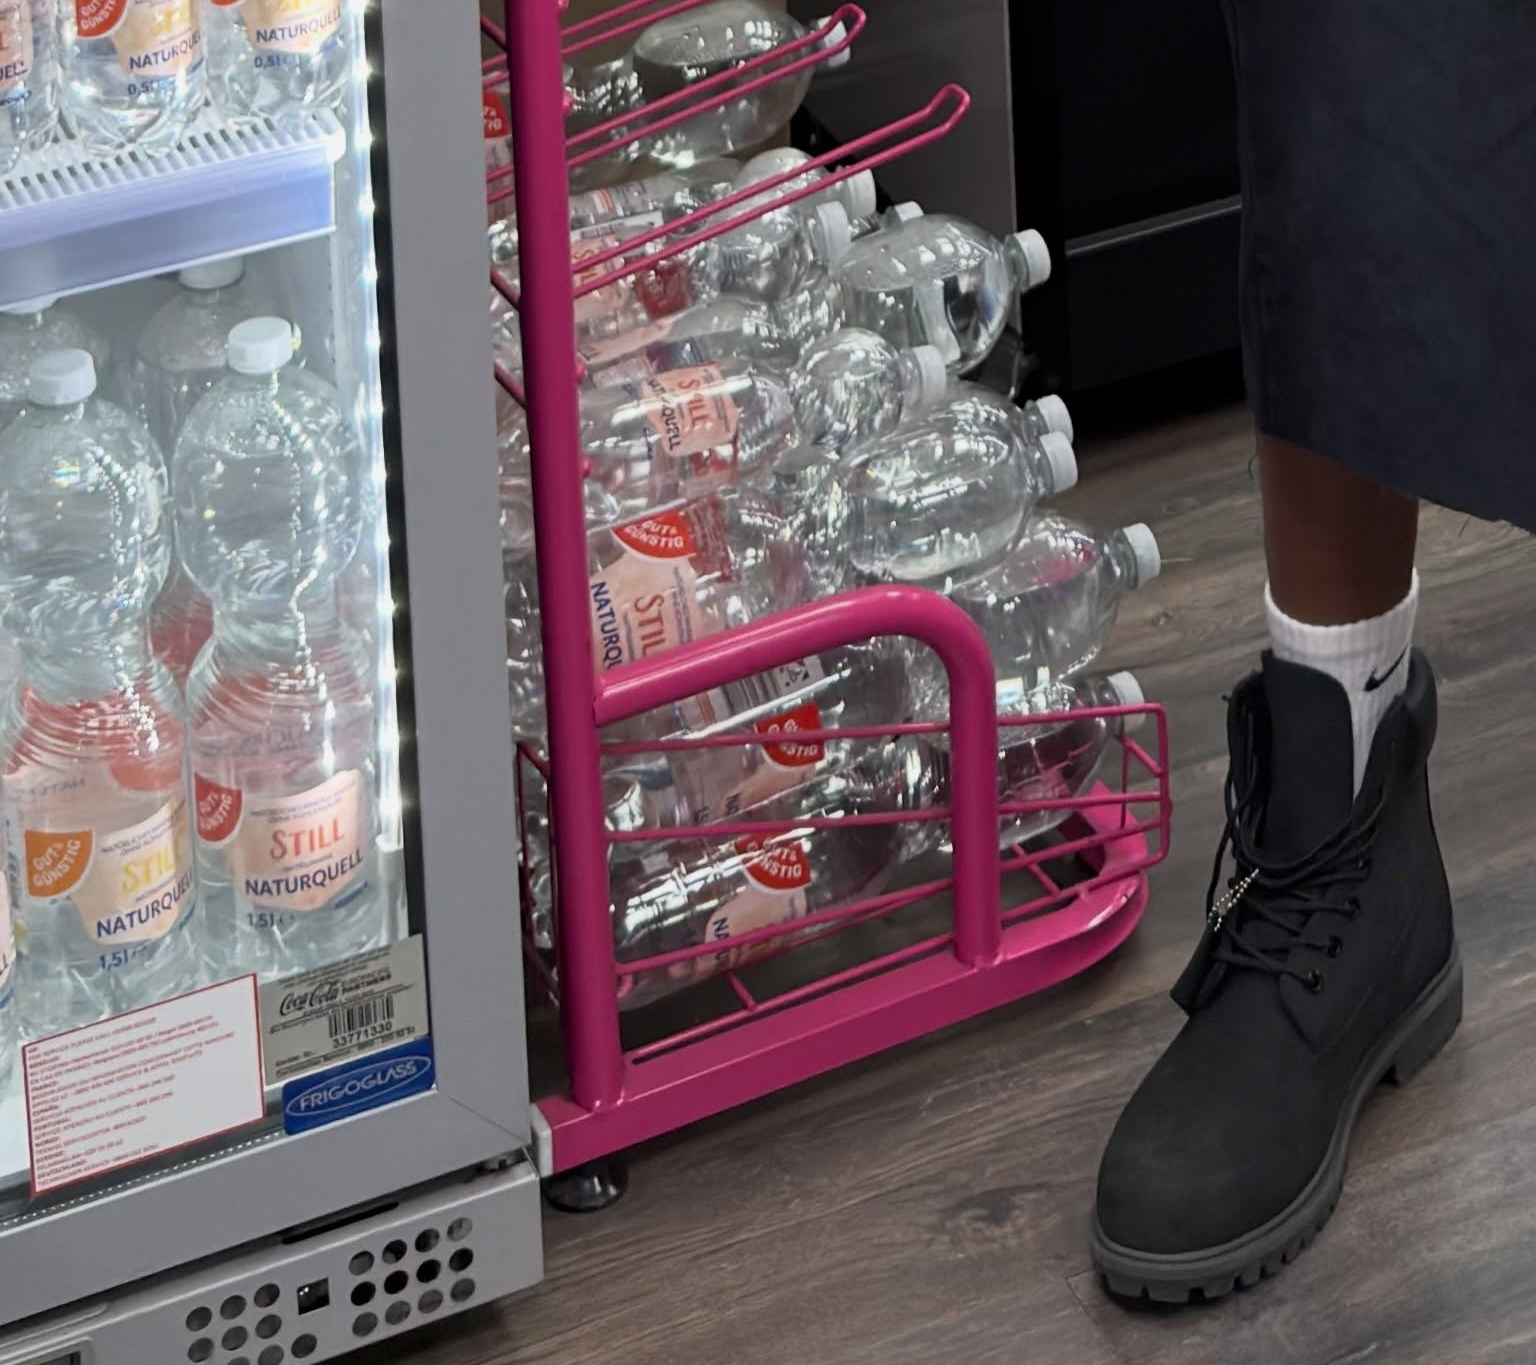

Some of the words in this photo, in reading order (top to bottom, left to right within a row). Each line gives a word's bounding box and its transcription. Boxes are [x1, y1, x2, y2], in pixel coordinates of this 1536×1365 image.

[255, 8, 342, 43] NATURQUELL
[635, 592, 666, 656] STIL
[33, 838, 81, 889] GÜNSTIG
[270, 819, 345, 861] STILL
[245, 849, 364, 897] NATURQUELL
[280, 981, 339, 1017] Coca-Cola
[300, 1061, 417, 1111] FRIGOGLASS
